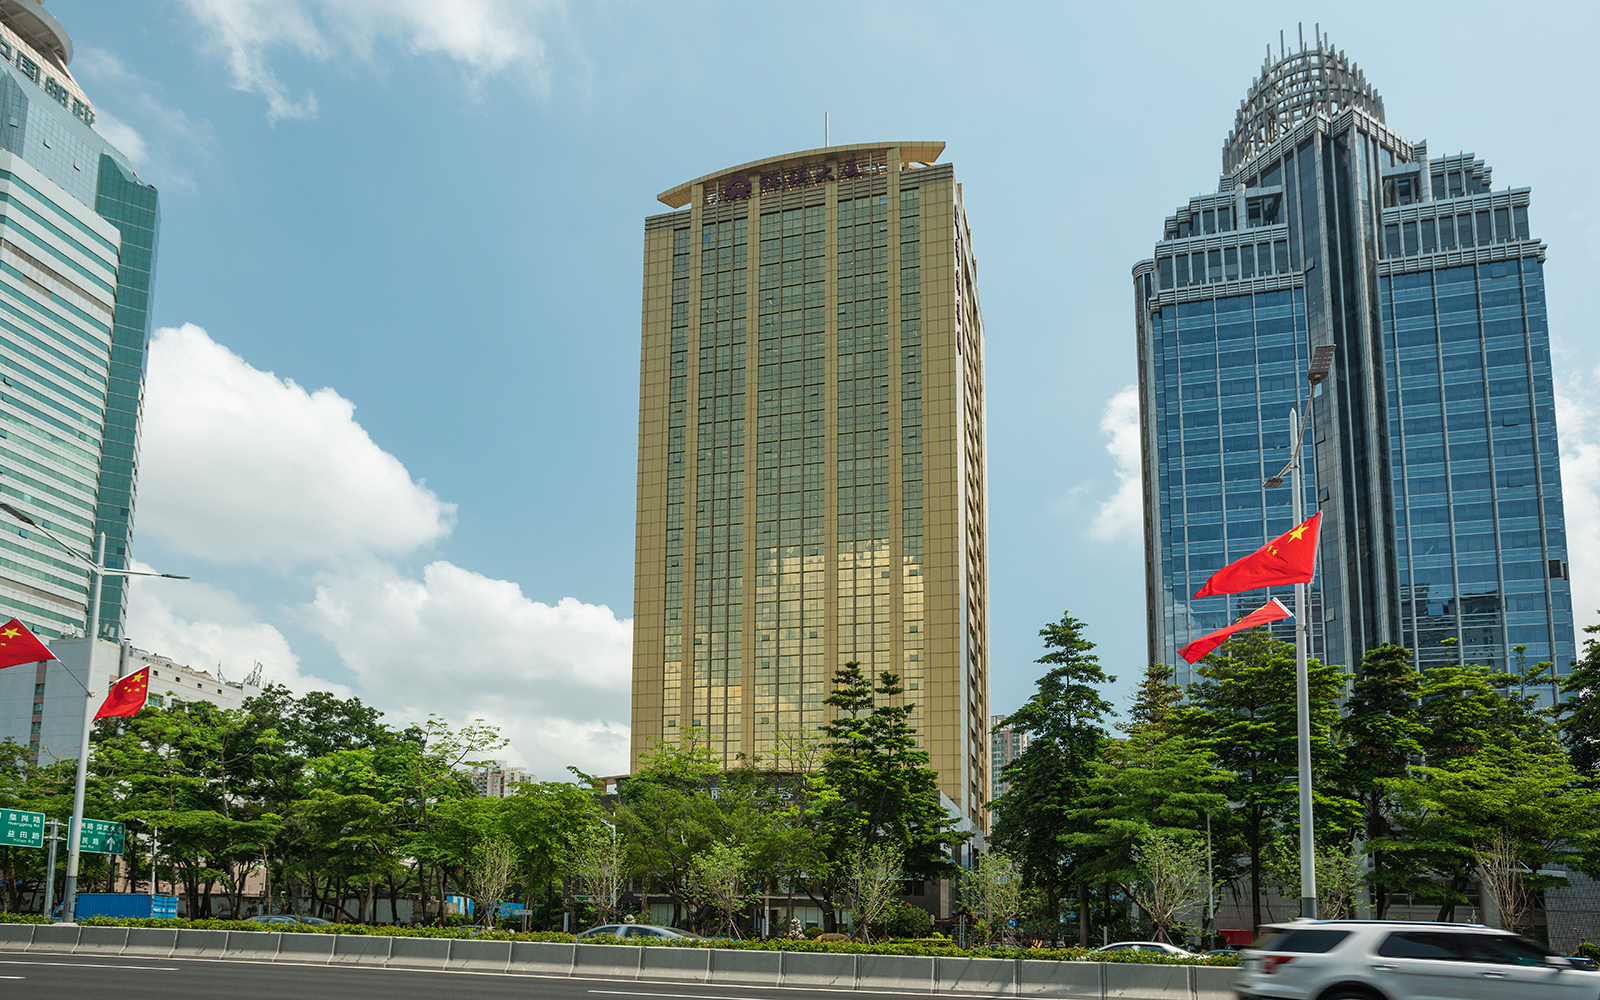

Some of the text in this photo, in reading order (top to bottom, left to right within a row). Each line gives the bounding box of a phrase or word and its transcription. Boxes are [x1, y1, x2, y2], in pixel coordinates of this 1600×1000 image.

[8, 813, 41, 824] 皇岗路
[7, 830, 40, 840] 益田路
